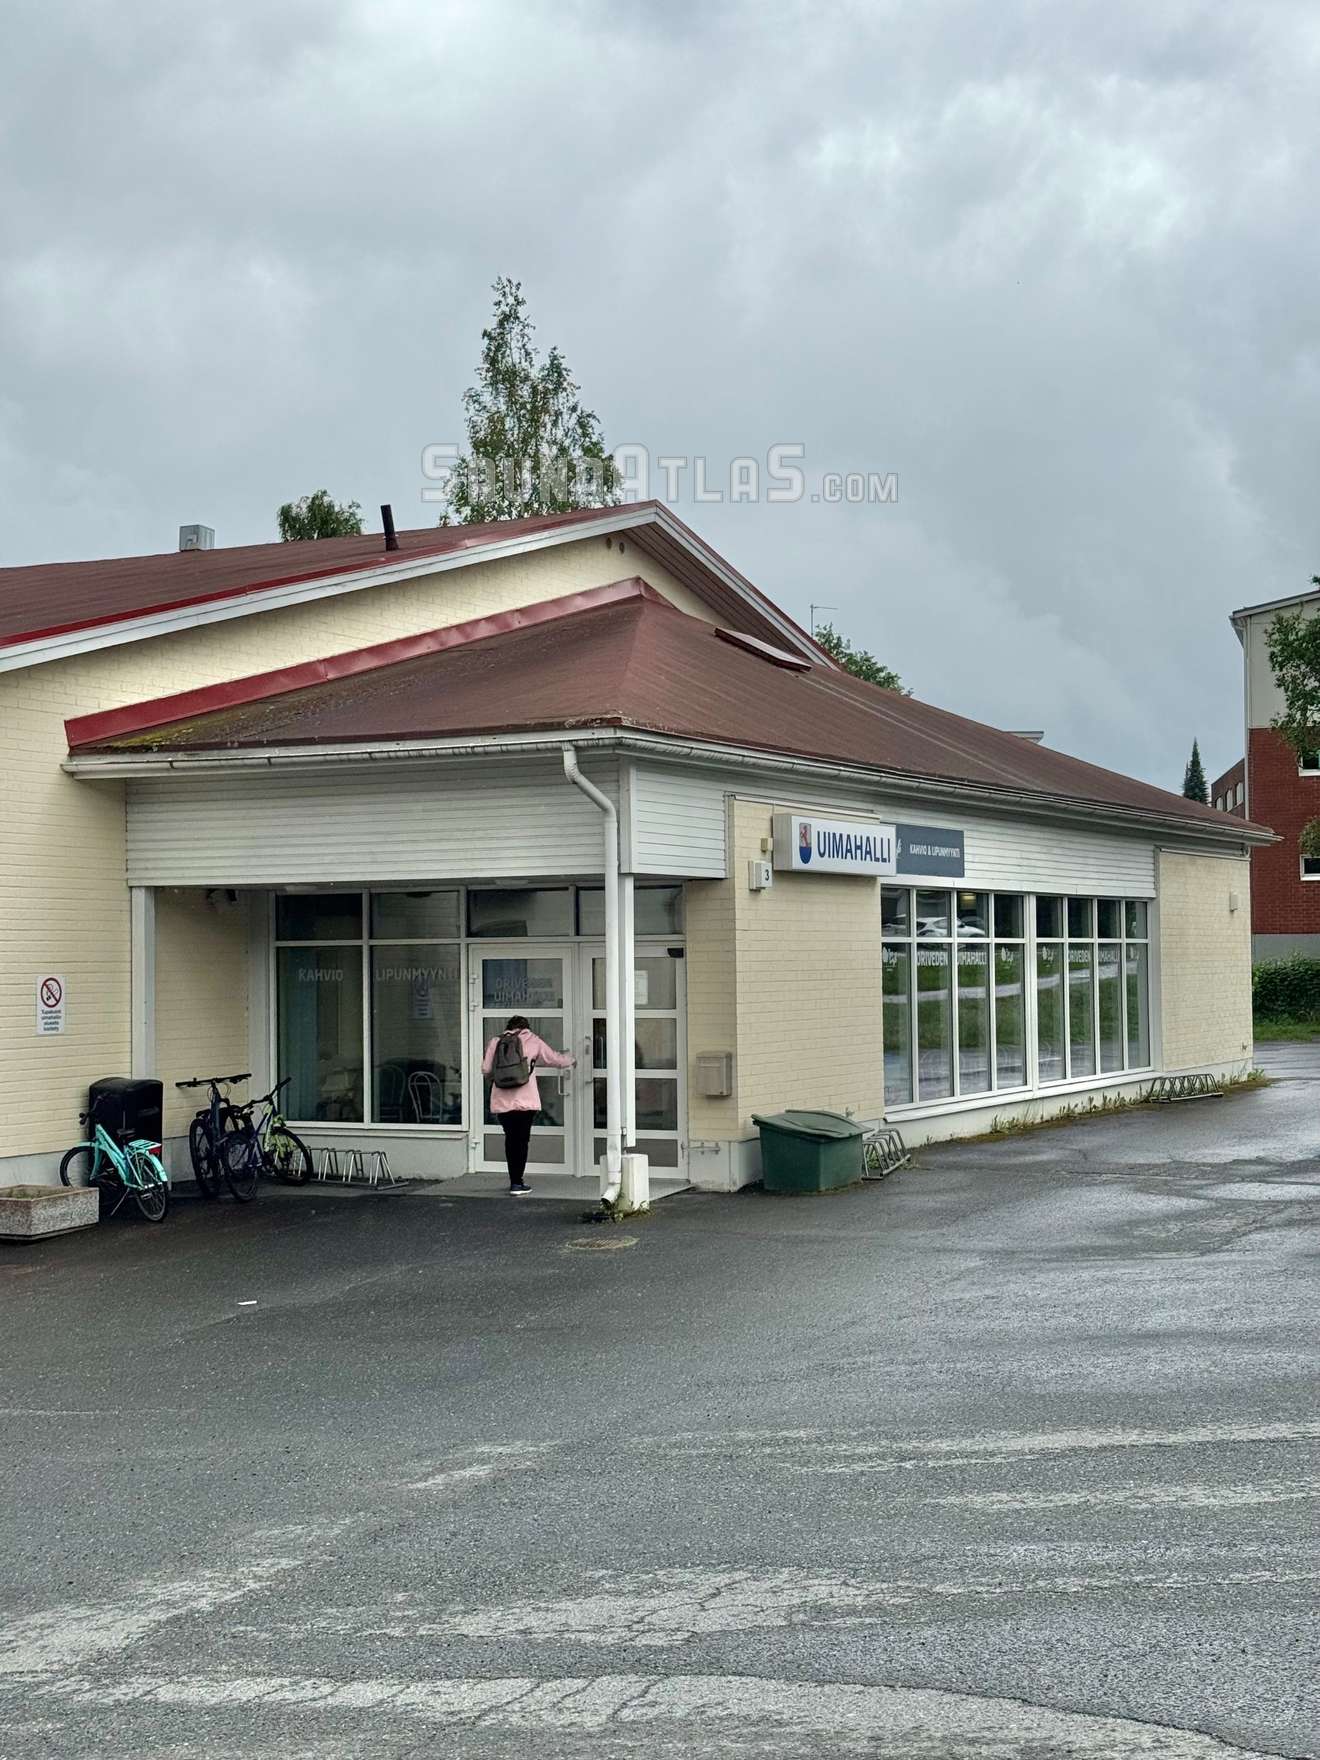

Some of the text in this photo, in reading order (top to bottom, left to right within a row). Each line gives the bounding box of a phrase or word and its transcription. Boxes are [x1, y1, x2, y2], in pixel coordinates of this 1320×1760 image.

[817, 831, 891, 864] UIMAHALLI
[765, 869, 770, 881] 3
[298, 968, 344, 982] KAHVIO
